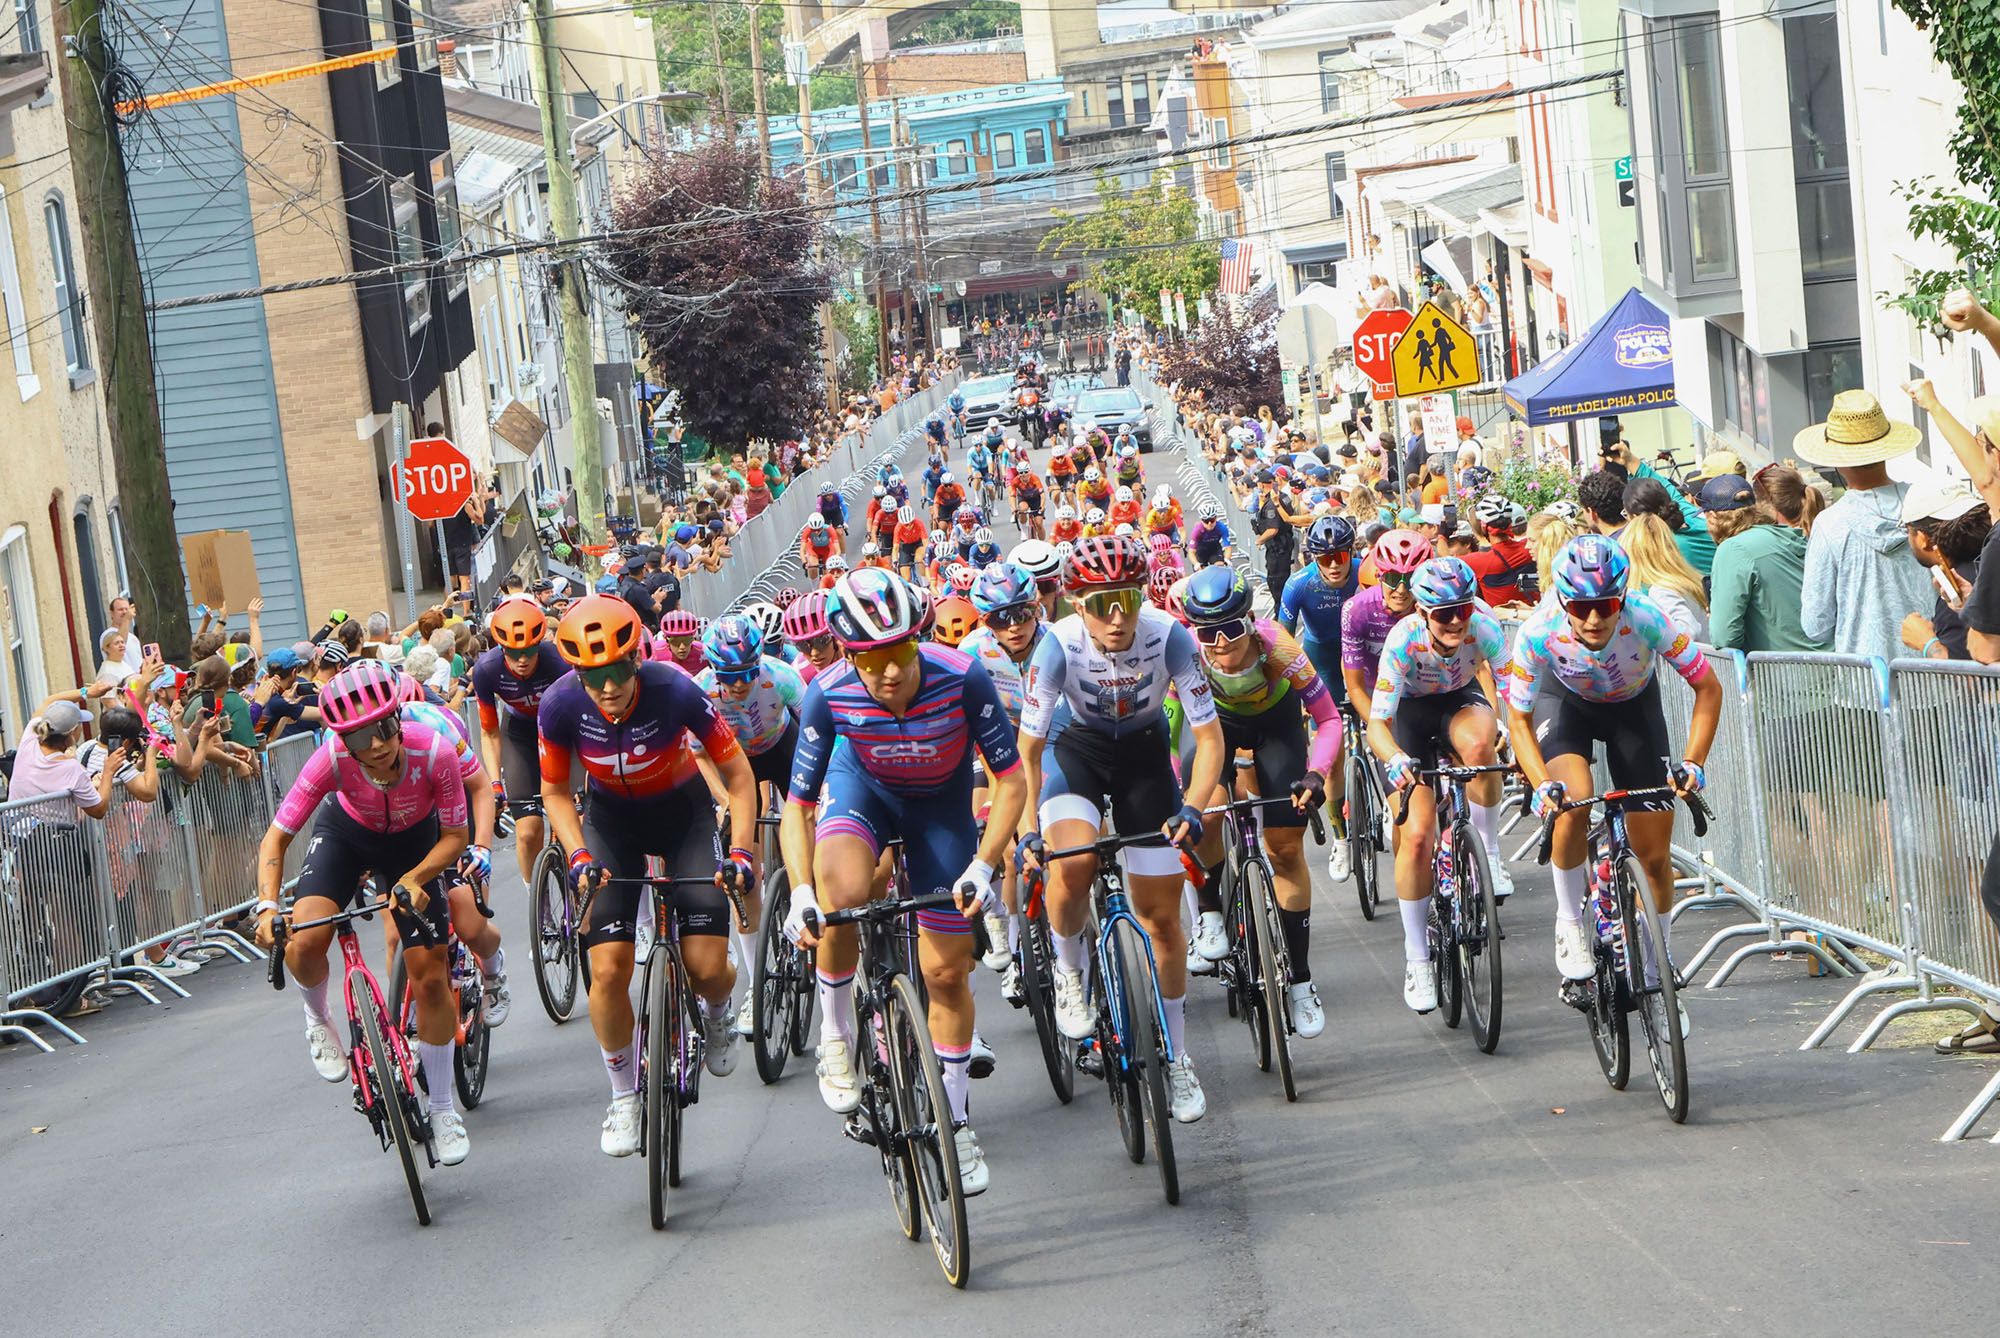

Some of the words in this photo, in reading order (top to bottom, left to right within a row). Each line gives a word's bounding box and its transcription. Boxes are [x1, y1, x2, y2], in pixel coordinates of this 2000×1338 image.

[942, 92, 984, 104] AND
[998, 86, 1026, 96] CO
[1358, 332, 1402, 363] ST
[1620, 335, 1670, 351] POLICE
[1375, 384, 1391, 393] ALL
[1549, 395, 1635, 418] PHILADELPHIA
[1637, 388, 1674, 405] POLIC
[1429, 414, 1449, 424] ANY
[1429, 425, 1452, 435] TIME
[403, 462, 467, 497] STOP
